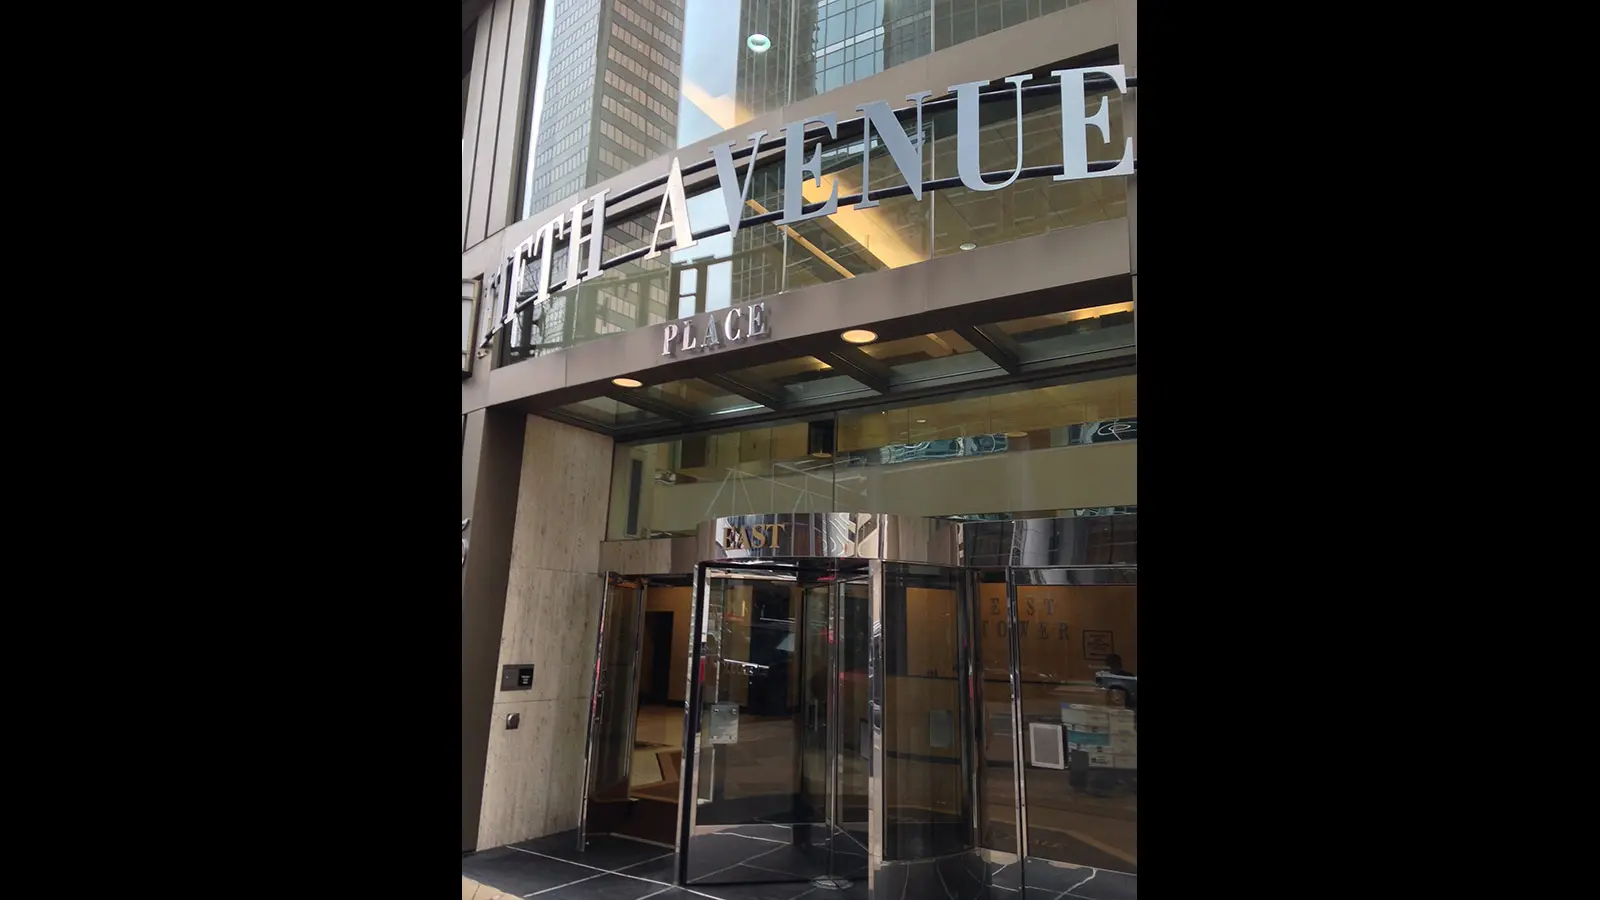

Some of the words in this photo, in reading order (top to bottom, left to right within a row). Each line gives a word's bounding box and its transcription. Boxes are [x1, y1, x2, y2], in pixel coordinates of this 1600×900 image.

[644, 65, 1135, 261] AVENUE
[660, 302, 766, 356] PLACE
[723, 523, 786, 551] EAST
[990, 597, 1055, 616] EST
